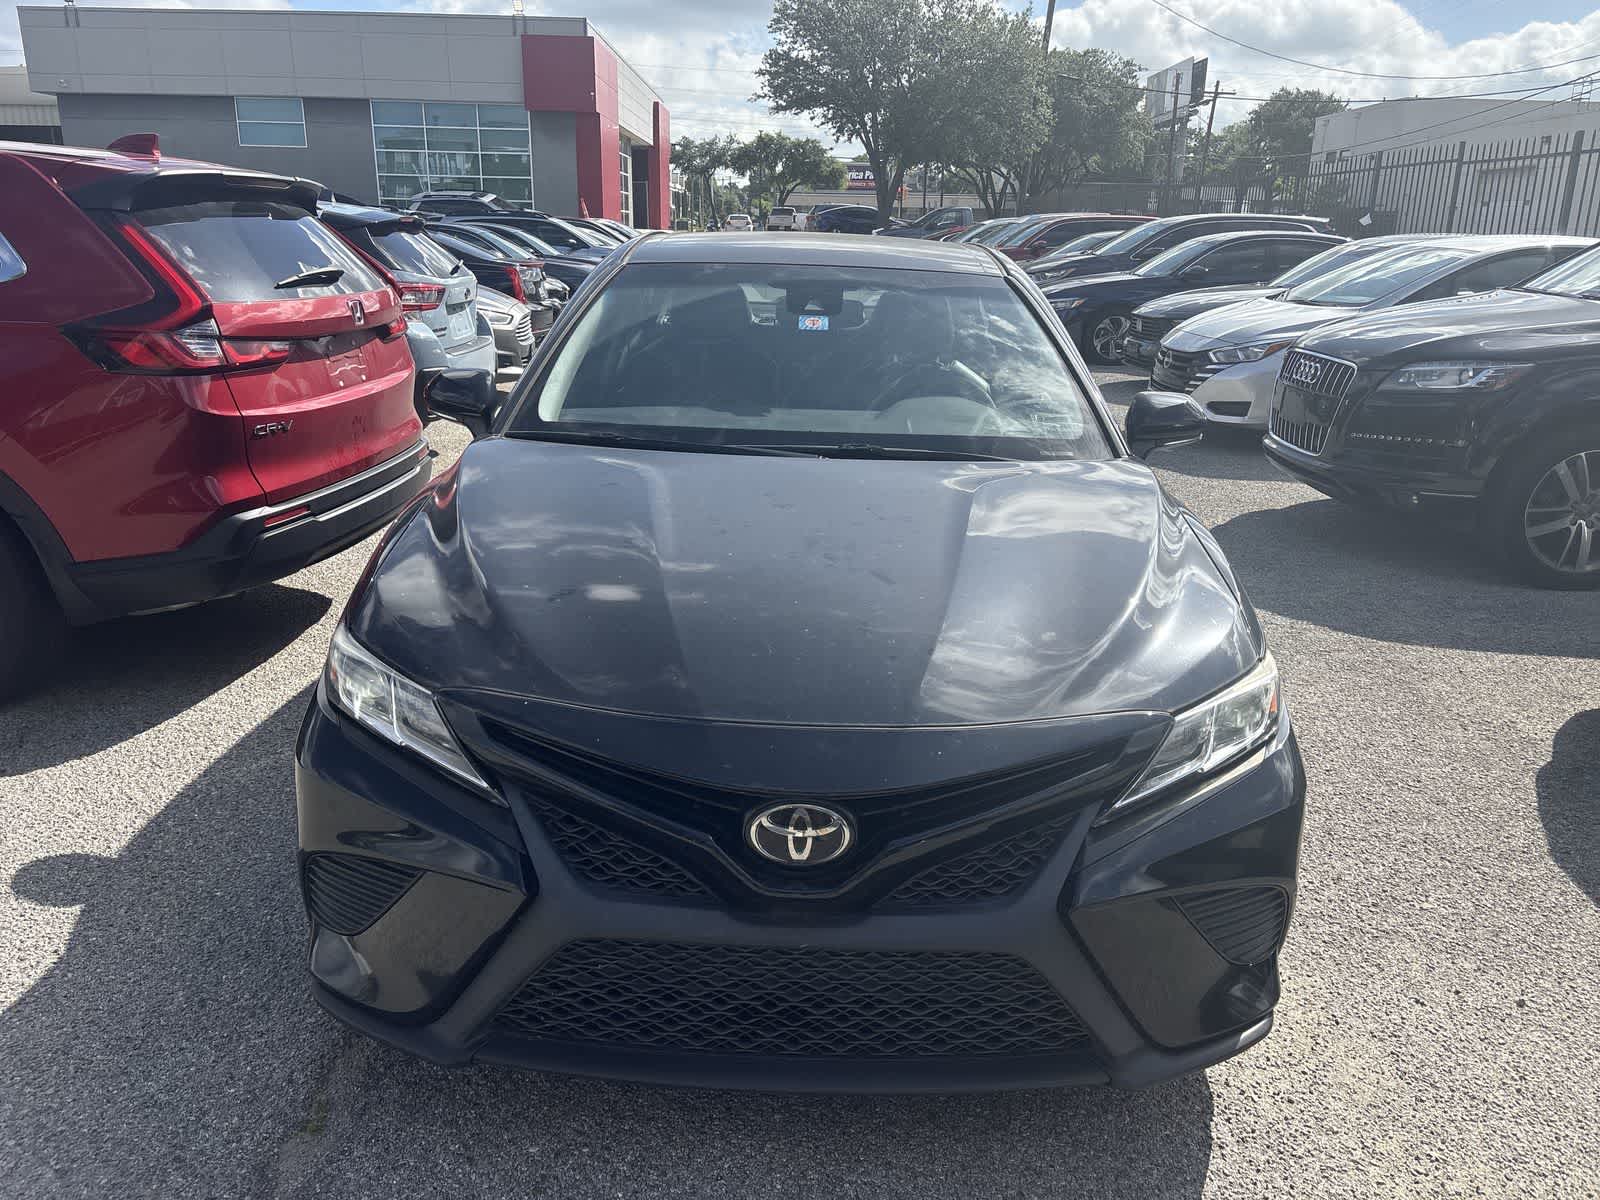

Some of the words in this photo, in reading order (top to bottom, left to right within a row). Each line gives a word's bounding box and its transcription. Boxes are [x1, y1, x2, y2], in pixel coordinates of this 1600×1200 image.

[848, 169, 863, 179] rica
[864, 170, 874, 179] Pa
[254, 419, 293, 435] CR-V
